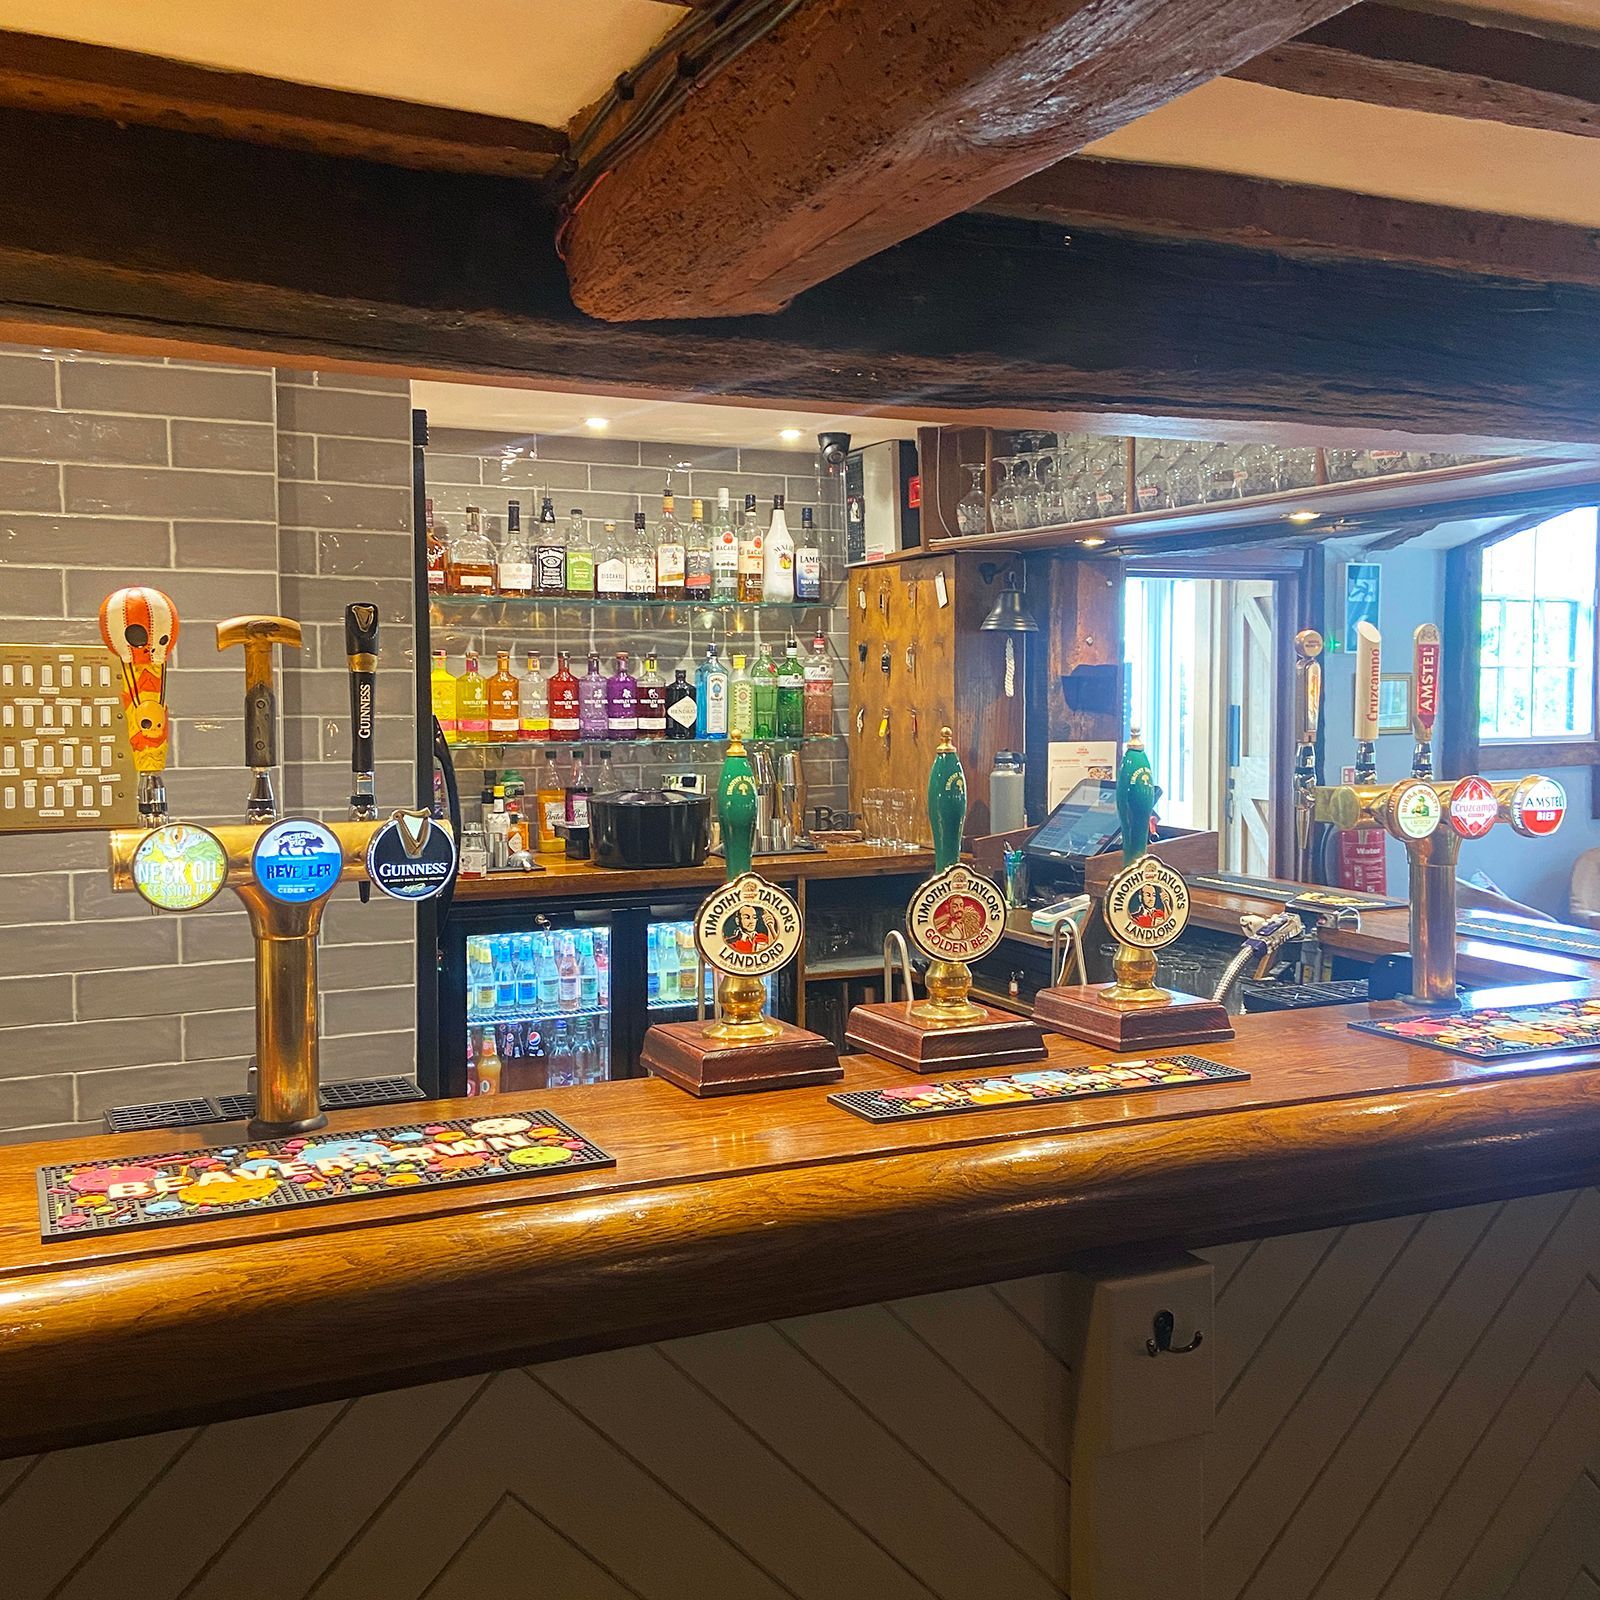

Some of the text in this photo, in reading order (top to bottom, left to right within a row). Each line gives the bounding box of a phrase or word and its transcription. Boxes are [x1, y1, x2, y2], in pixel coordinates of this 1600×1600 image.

[1367, 648, 1380, 722] Cruzcampo
[1420, 647, 1435, 712] AMSTEL
[358, 684, 371, 739] GUINNESS
[1454, 802, 1497, 813] Cruzcampo
[1525, 796, 1563, 808] AMSTEL
[813, 805, 863, 831] Bar
[1536, 811, 1556, 821] BIER
[278, 832, 318, 846] ORCHARD
[289, 839, 307, 849] PIG
[1355, 847, 1381, 855] Water
[136, 860, 220, 884] NECK OIL
[379, 861, 448, 878] GUINNESS
[195, 881, 215, 897] IPA
[1113, 869, 1187, 913] TIMOTHY TAYLOR'S
[705, 888, 796, 938] TIMOTHY TAYLOR'S
[917, 879, 1002, 926] TIMOTHY TAYLOR'S
[925, 924, 994, 953] GOLDEN BEST
[1124, 918, 1177, 940] LANDLORD
[718, 942, 785, 967] LANDLORD
[106, 1133, 532, 1200] BEAVERTOWN
